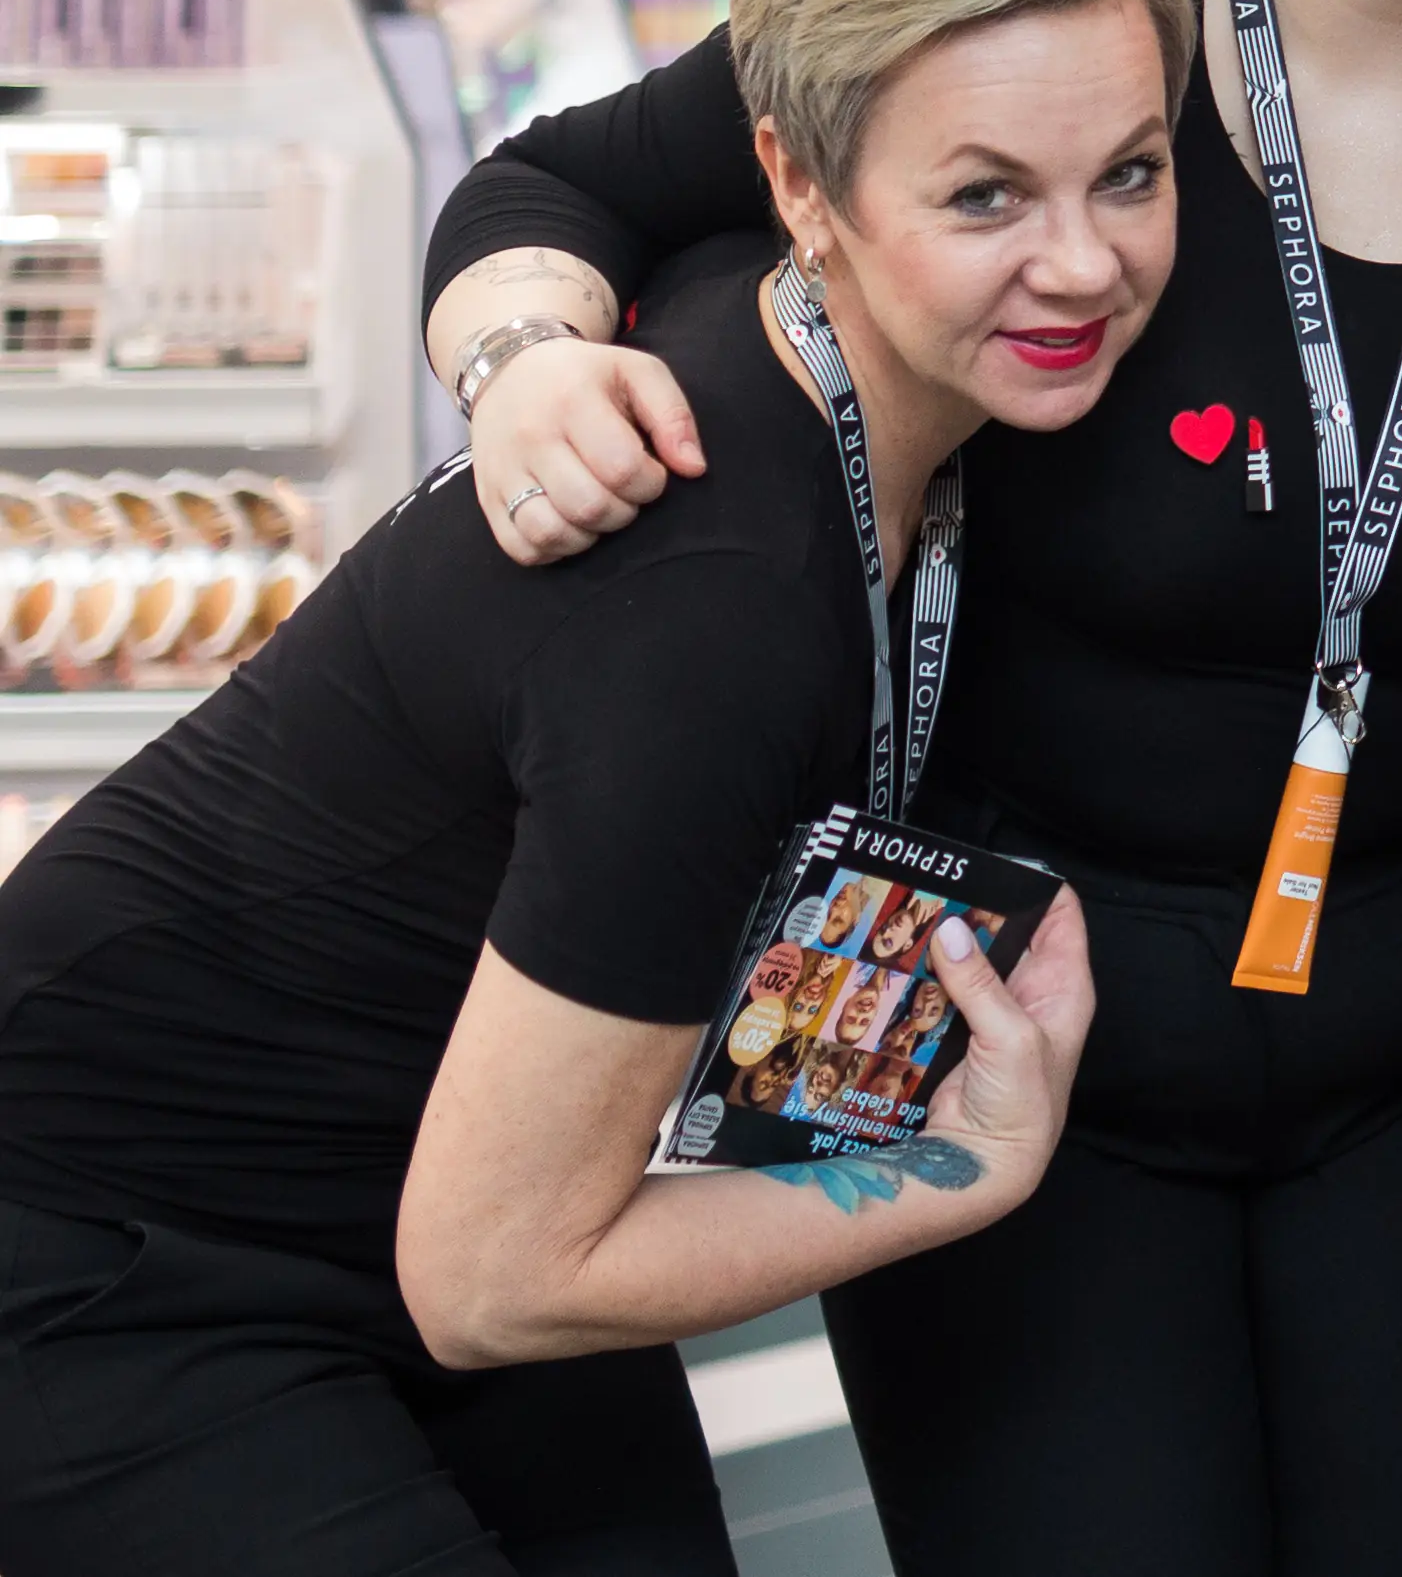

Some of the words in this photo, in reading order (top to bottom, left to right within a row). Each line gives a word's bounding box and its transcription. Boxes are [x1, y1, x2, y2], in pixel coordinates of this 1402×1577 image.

[1269, 172, 1322, 334] SEPHORA
[839, 403, 881, 575] SEPHORA
[853, 827, 969, 881] SEPHORA
[755, 968, 794, 993] -20%
[732, 1027, 775, 1053] -20%
[783, 1096, 809, 1121] się
[842, 1087, 895, 1118] Ciebie
[897, 1102, 926, 1125] dla
[811, 1102, 915, 1143] zmieniliśmy
[809, 1132, 842, 1157] jak
